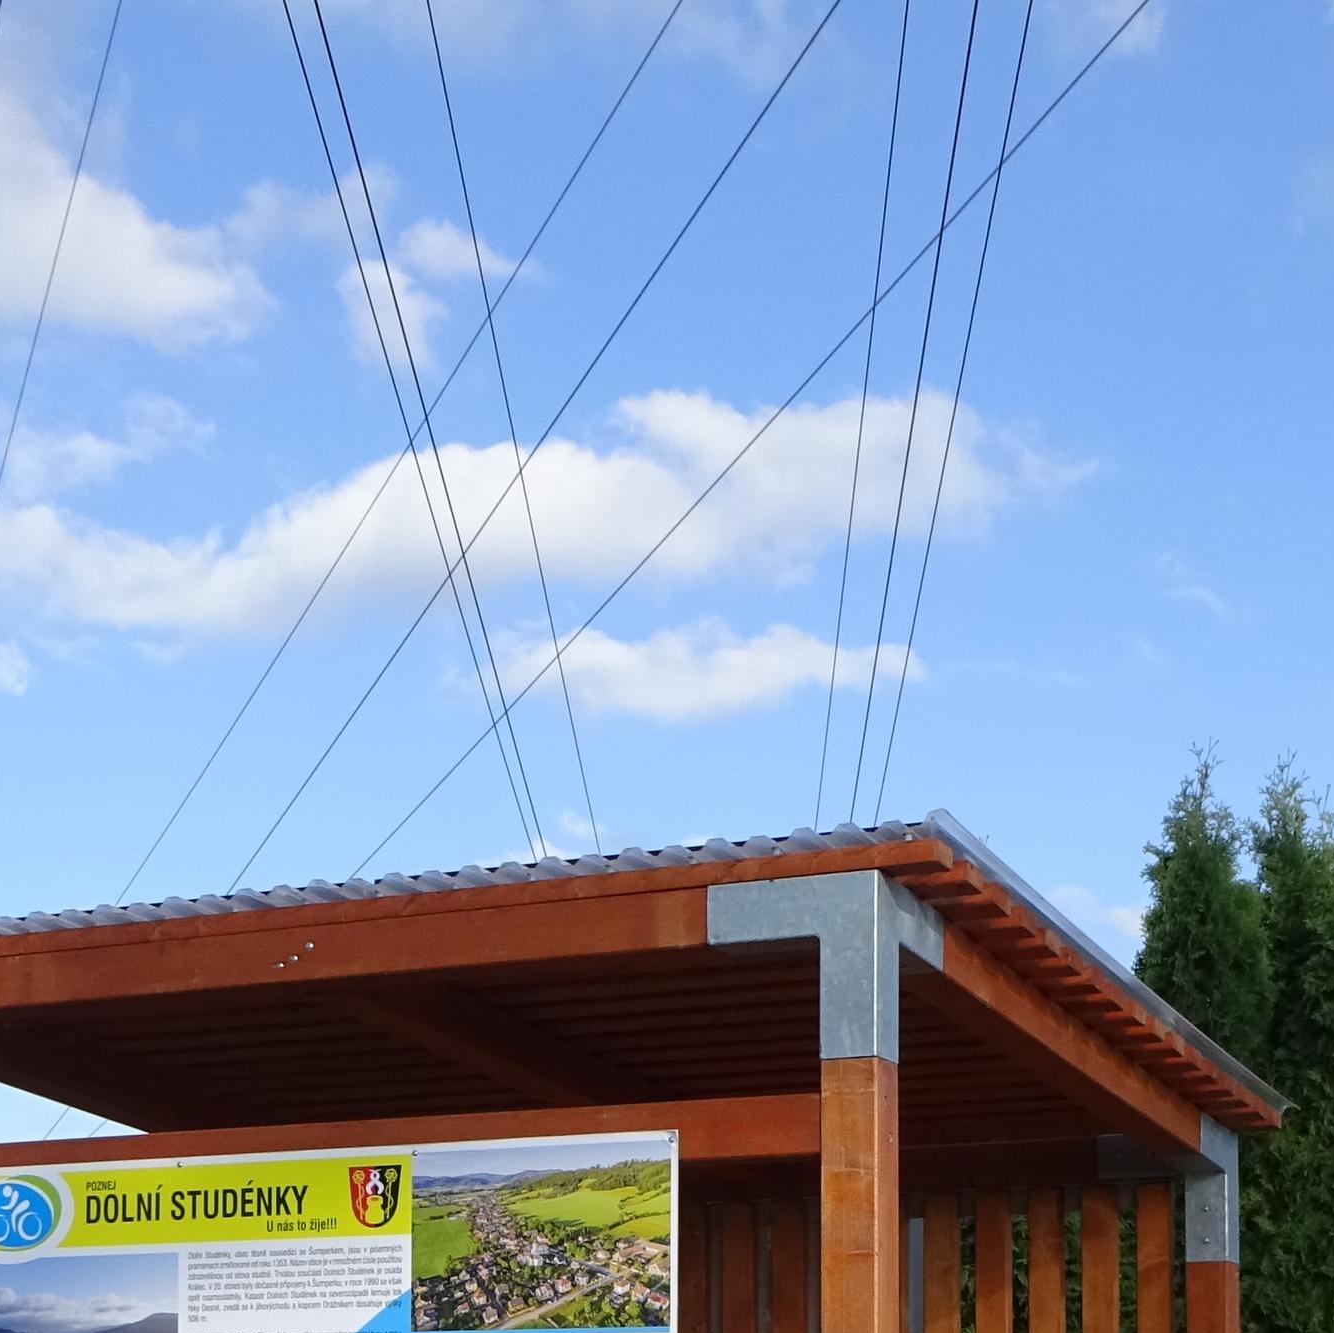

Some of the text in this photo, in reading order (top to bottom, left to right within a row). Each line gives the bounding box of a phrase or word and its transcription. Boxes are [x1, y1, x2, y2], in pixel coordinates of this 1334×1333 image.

[86, 1180, 117, 1191] POZNEJ
[86, 1180, 307, 1223] DOLNÍ STUDÉNKY
[266, 1218, 337, 1232] U nás to žije!!!
